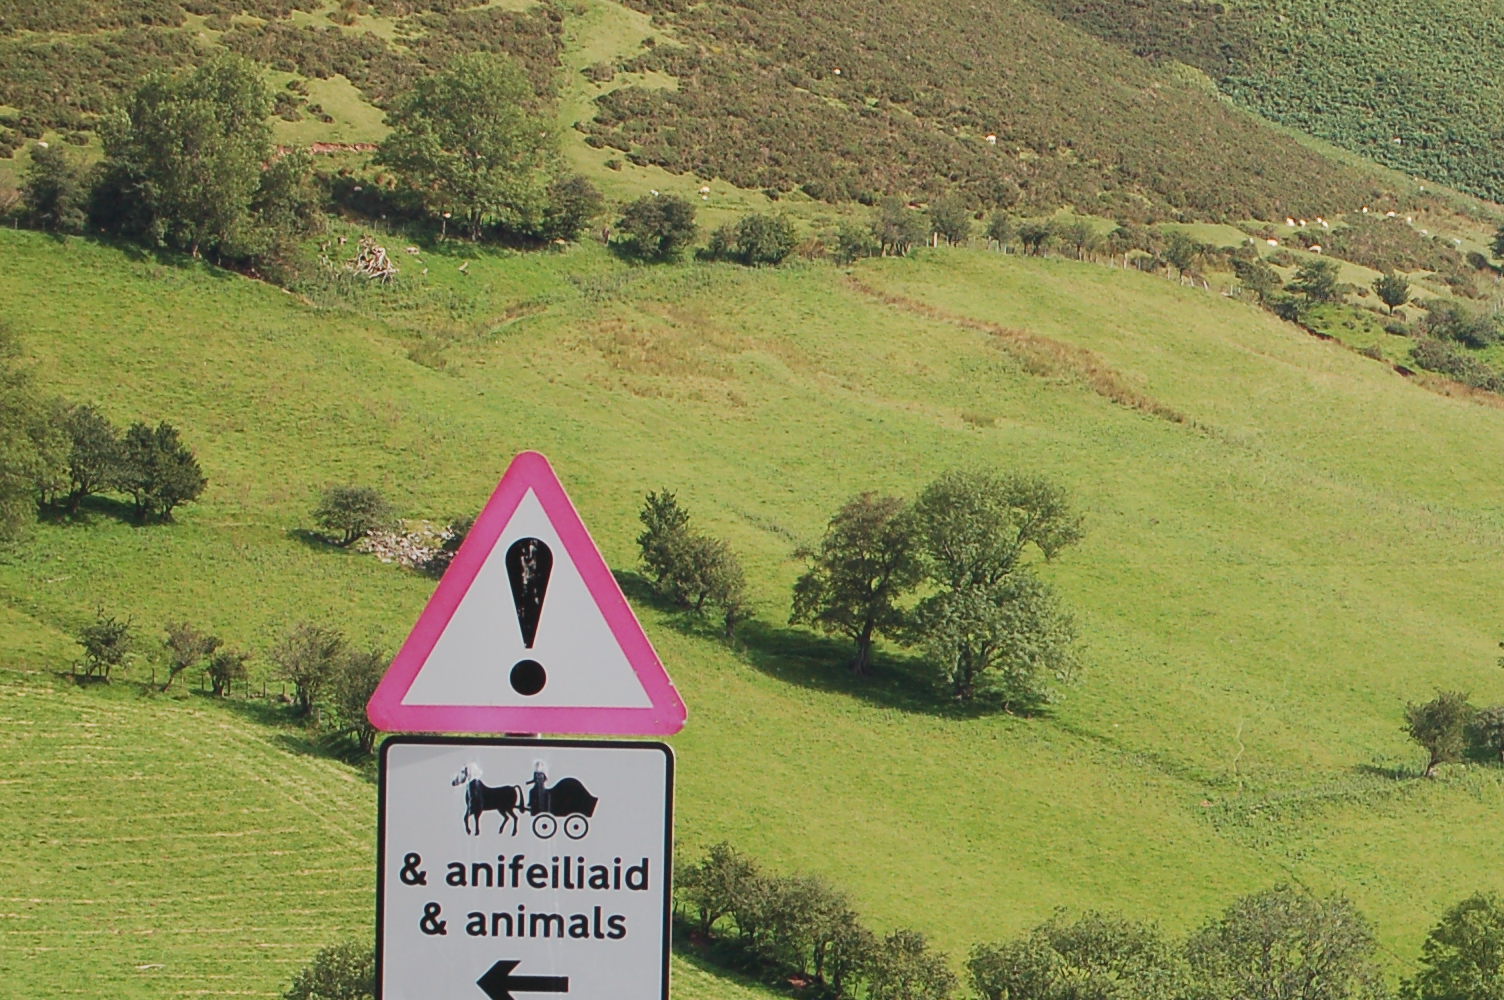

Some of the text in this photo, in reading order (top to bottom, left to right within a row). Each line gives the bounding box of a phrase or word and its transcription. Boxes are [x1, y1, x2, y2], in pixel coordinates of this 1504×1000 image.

[399, 852, 649, 891] & anifeiliaid
[419, 901, 627, 940] & animals
